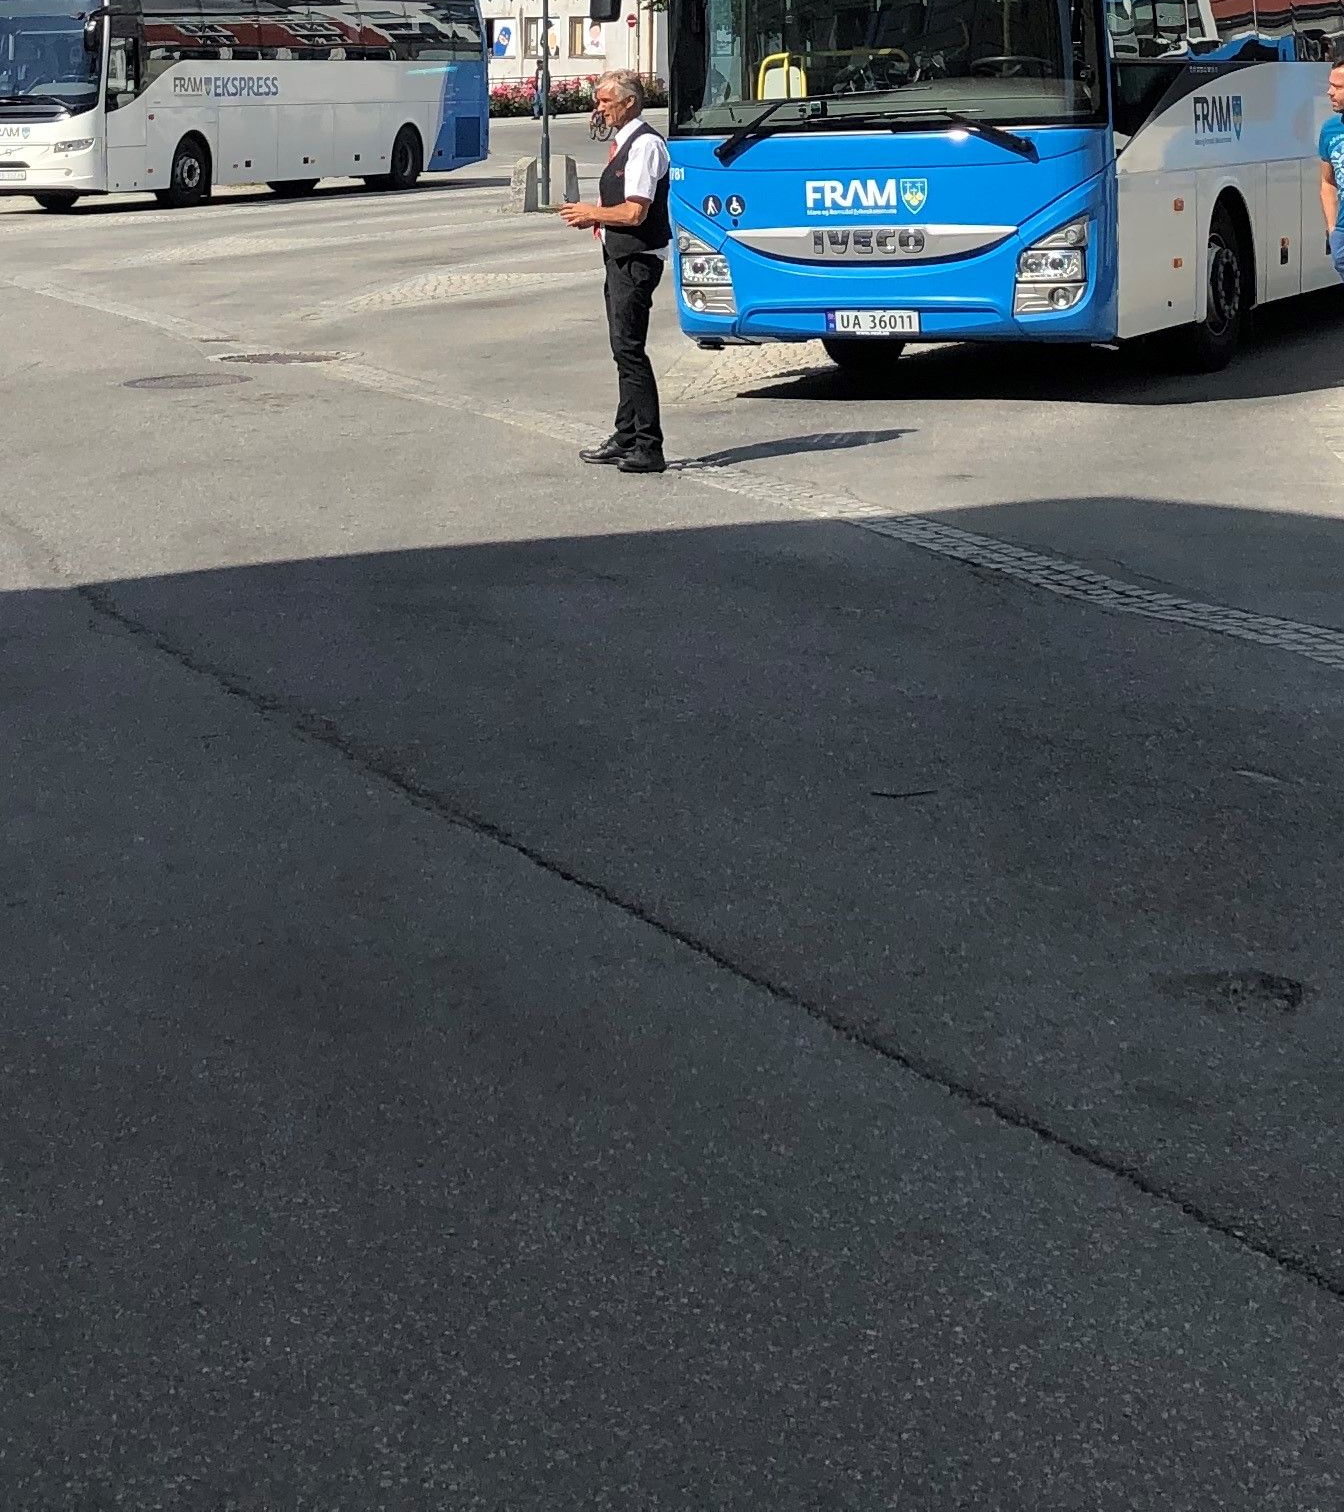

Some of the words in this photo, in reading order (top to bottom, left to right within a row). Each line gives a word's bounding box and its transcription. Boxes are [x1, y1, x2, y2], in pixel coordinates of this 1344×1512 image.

[173, 76, 203, 93] FRAM
[214, 76, 279, 97] EKSPRESS
[1193, 95, 1231, 134] FRAM
[805, 178, 897, 208] FRAM
[813, 228, 925, 255] IVECO
[840, 314, 862, 330] UA
[868, 314, 913, 330] 36011
